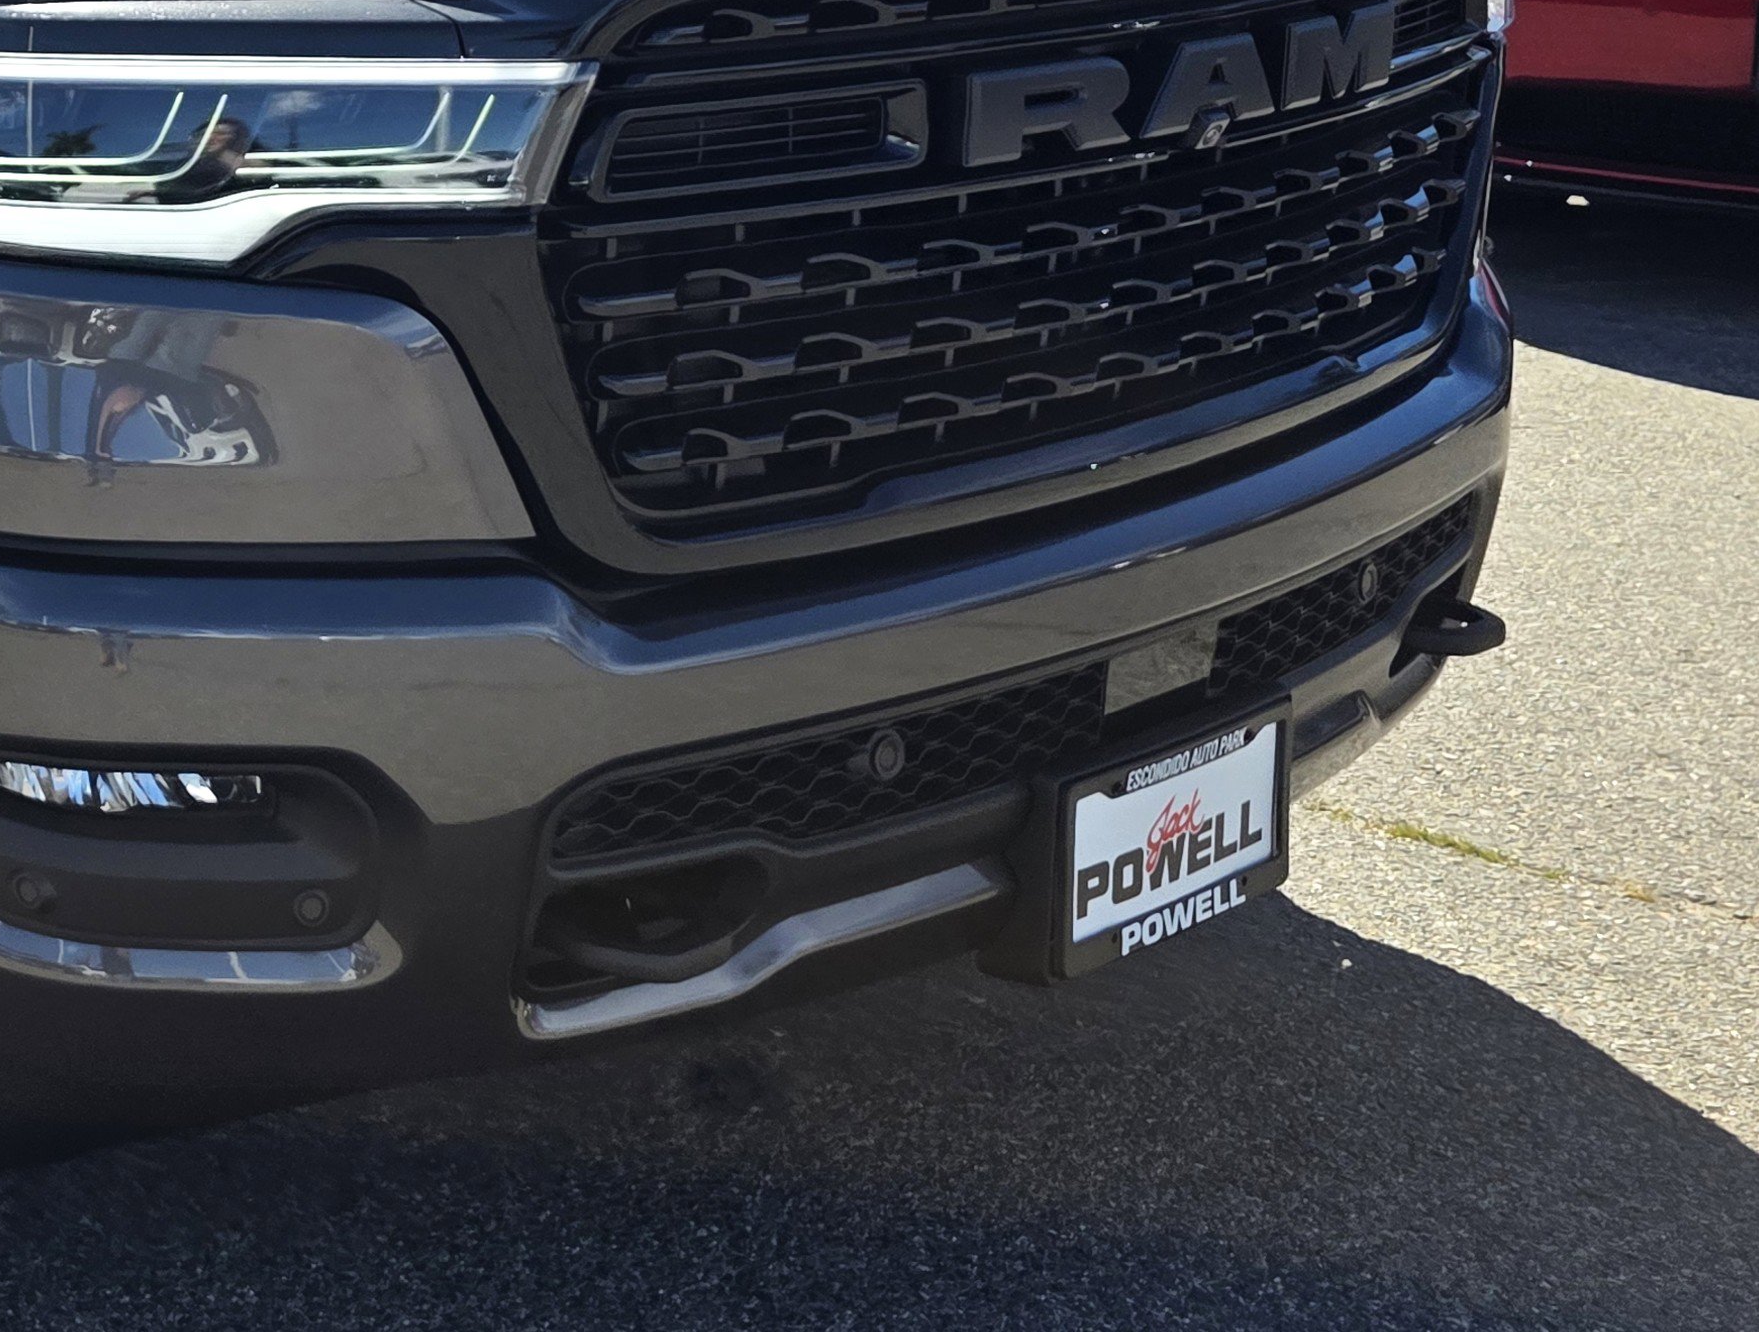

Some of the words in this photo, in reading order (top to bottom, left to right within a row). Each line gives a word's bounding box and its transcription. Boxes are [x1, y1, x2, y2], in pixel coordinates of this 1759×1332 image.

[1126, 750, 1190, 791] ESCONDIDO
[1189, 738, 1219, 768] AUTO
[1219, 727, 1248, 757] PARK
[1076, 799, 1263, 921] POWELL
[1146, 788, 1205, 873] Jack
[1121, 878, 1247, 957] POWELL
